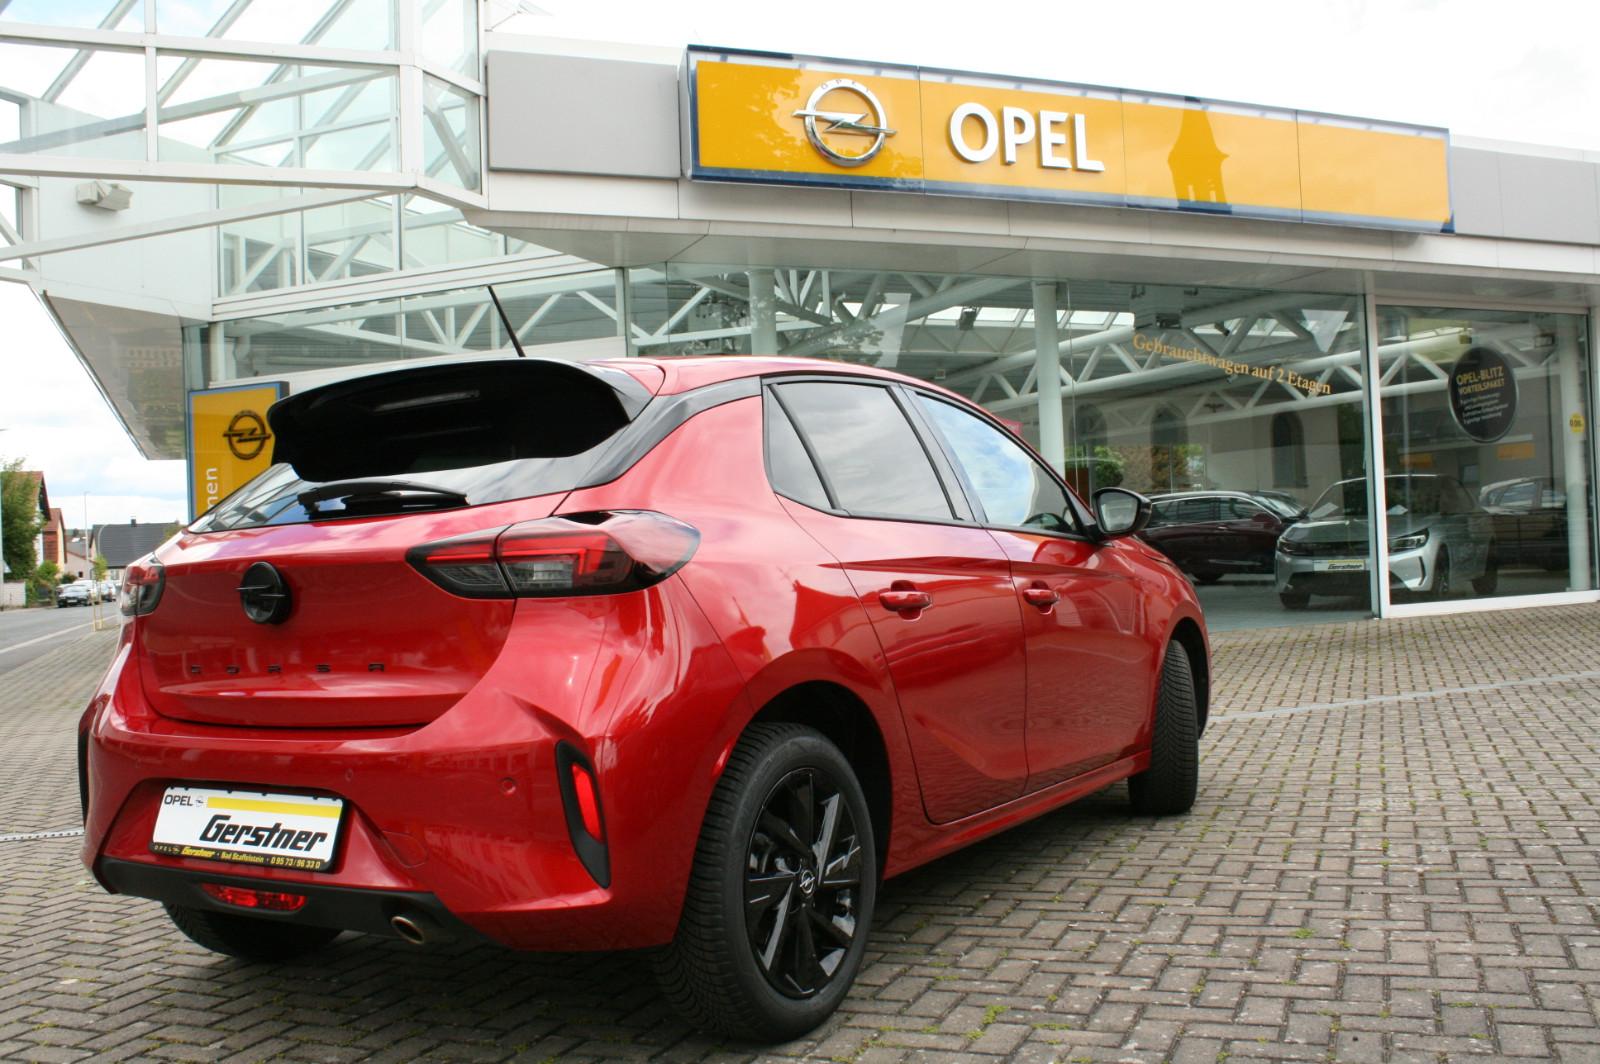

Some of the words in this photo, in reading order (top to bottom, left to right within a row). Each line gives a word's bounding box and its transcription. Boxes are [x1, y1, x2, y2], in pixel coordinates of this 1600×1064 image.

[821, 79, 871, 93] OPEL
[949, 101, 1106, 173] OPEL
[1132, 333, 1250, 375] Gebrauchtwagen
[1251, 364, 1275, 381] auf
[1276, 367, 1285, 383] 2
[1286, 370, 1331, 395] Etagen
[1456, 366, 1505, 385] OPEL-BLITZ
[163, 794, 194, 807] OPEL
[199, 814, 328, 852] Gerstner
[181, 846, 216, 858] Gerstner
